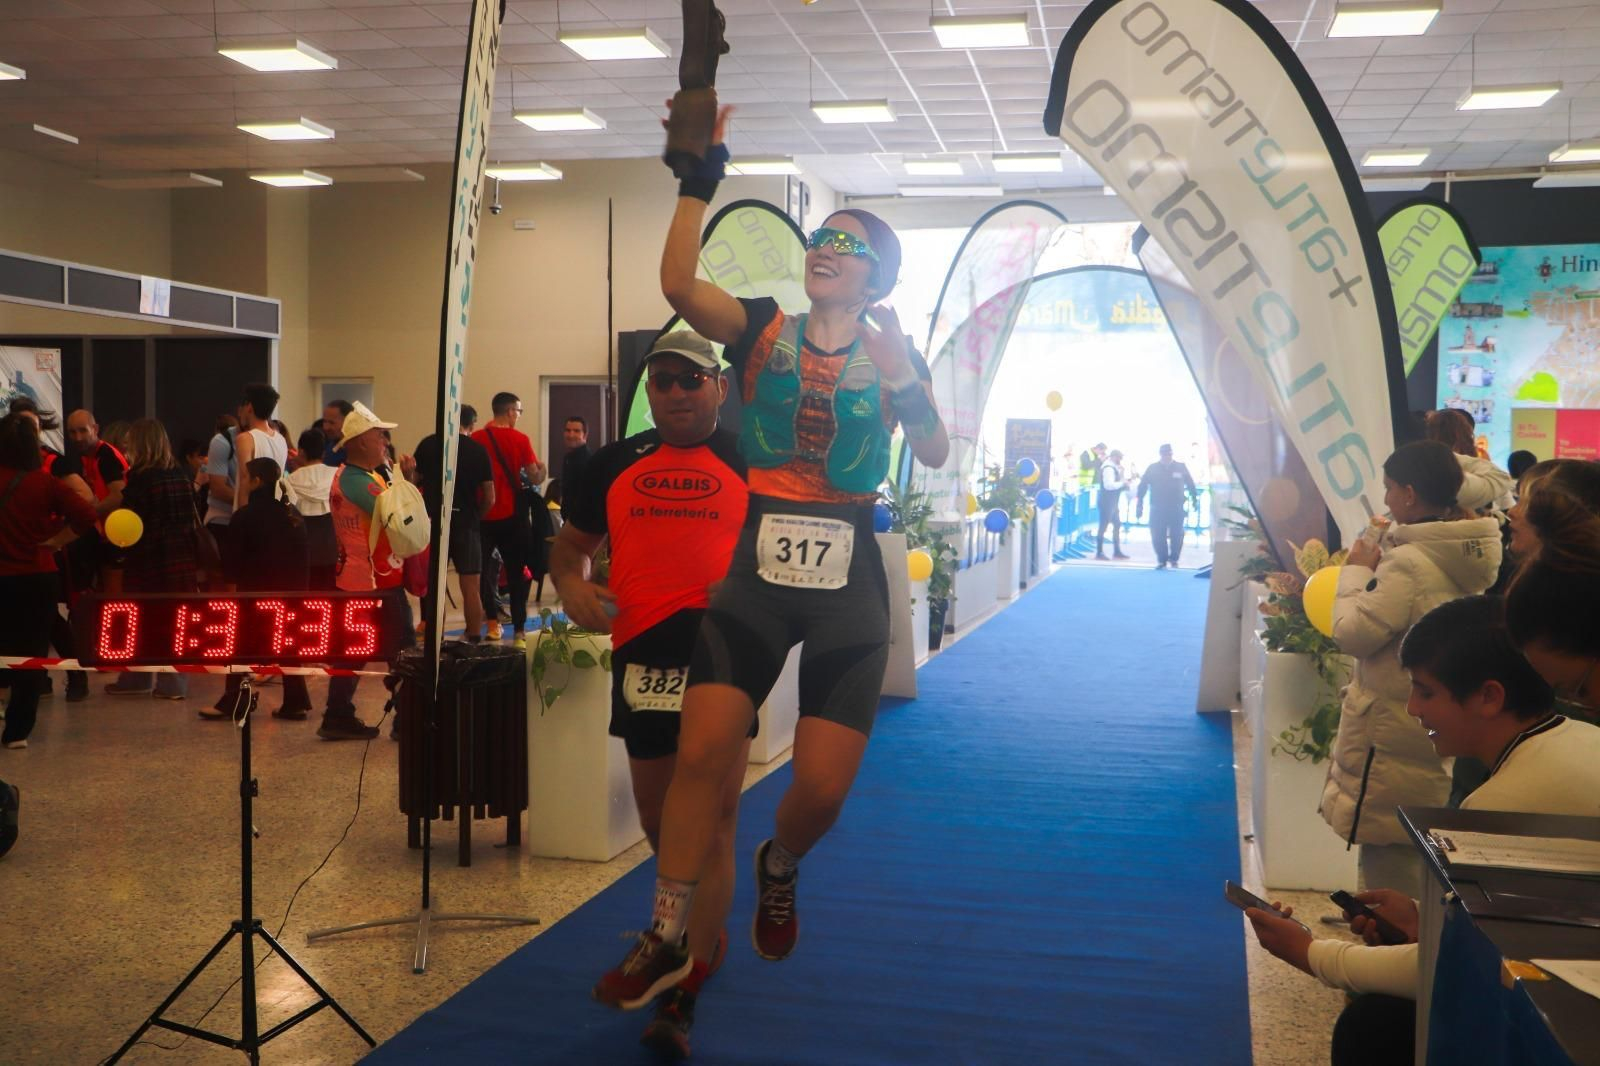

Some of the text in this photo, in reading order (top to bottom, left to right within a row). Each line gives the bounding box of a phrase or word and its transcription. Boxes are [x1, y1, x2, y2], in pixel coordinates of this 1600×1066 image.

[1562, 255, 1600, 272] Hin
[642, 477, 711, 491] GALBIS
[630, 506, 646, 517] La
[775, 536, 832, 567] 317
[636, 675, 684, 695] 382
